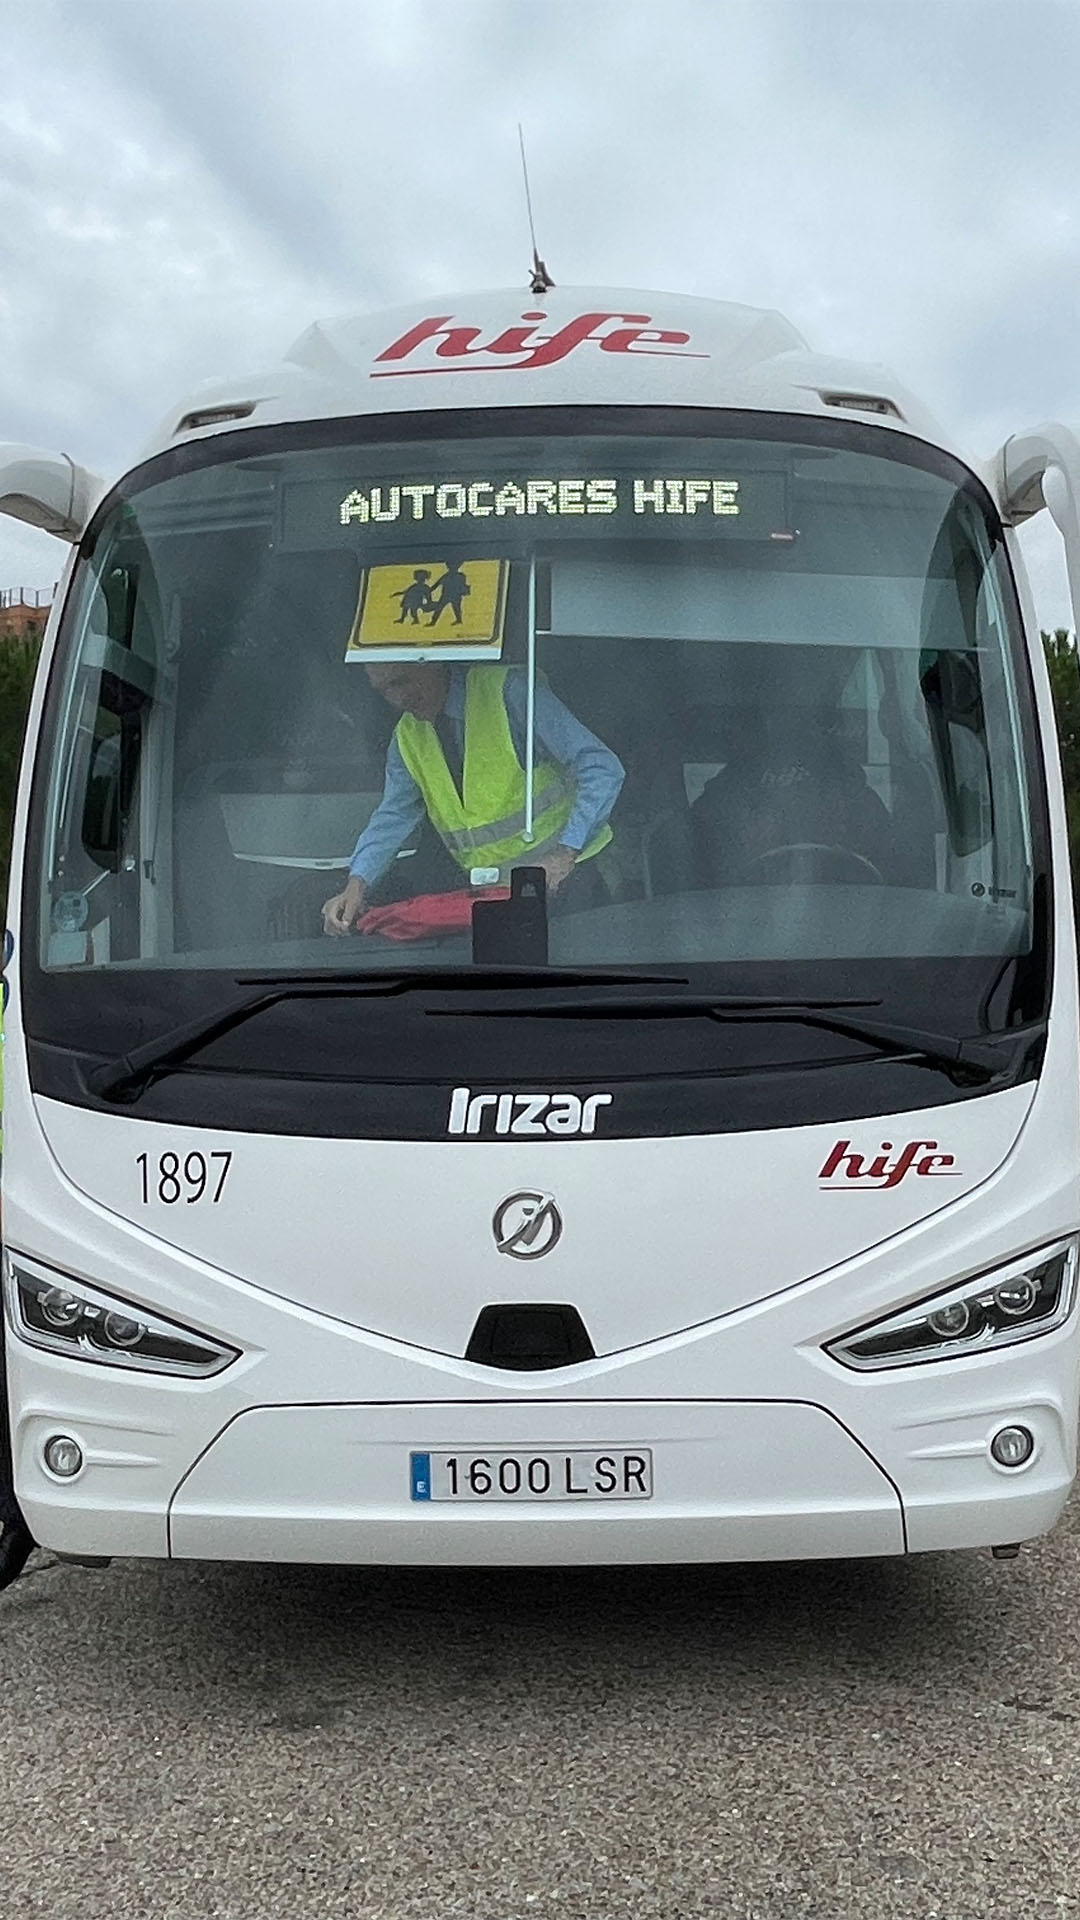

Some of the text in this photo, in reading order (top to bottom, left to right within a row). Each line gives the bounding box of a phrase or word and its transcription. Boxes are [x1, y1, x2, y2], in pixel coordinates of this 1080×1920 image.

[370, 312, 711, 378] hife
[340, 480, 741, 526] AUTOCARES HIFE
[447, 1087, 613, 1135] Irizar
[135, 1151, 234, 1204] 1897
[818, 1140, 963, 1190] hife
[416, 1456, 647, 1495] E 1600 LSR
